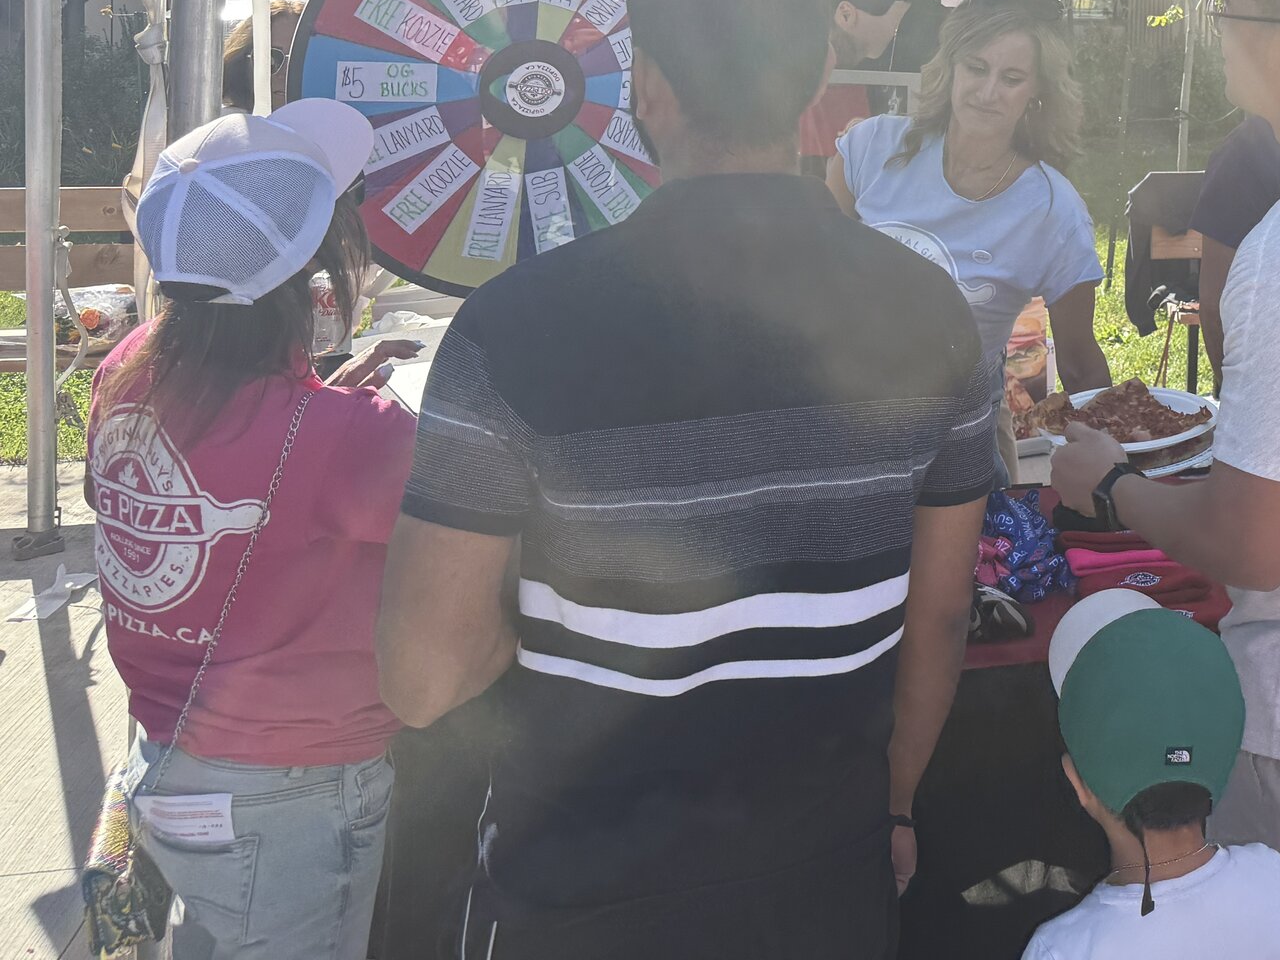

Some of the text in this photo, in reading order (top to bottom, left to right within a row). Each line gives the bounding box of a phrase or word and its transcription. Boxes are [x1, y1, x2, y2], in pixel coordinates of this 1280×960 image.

[396, 6, 456, 56] KOOZIE
[341, 63, 366, 100] $5
[380, 80, 429, 97] BUCKS
[386, 113, 447, 157] LANYARD
[389, 149, 473, 227] FREE KOOZIE
[530, 171, 561, 206] SUB
[573, 150, 635, 220] REE KOOZIE
[467, 170, 515, 261] FREE LANYARD
[150, 450, 174, 492] UYS
[98, 487, 199, 534] G PIZZA
[143, 563, 184, 597] PIES
[105, 602, 215, 645] PIZZA.CA
